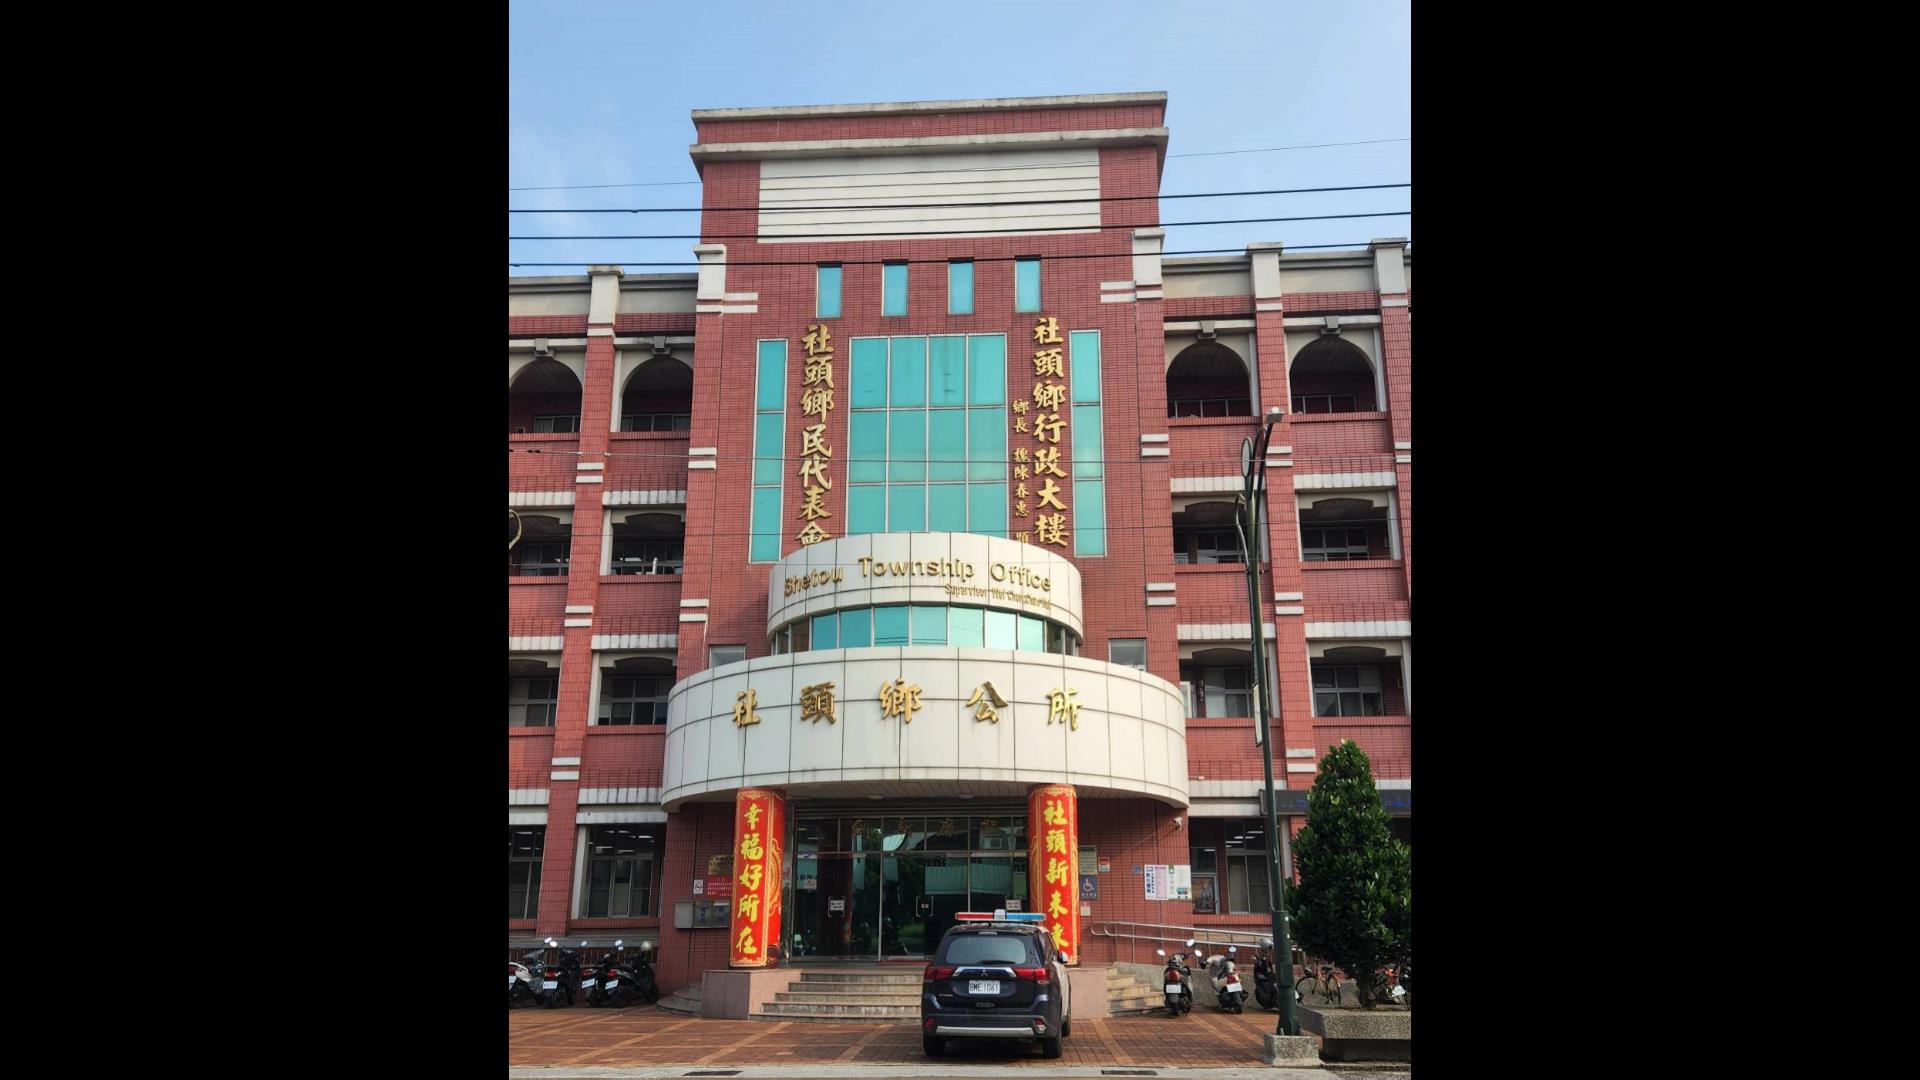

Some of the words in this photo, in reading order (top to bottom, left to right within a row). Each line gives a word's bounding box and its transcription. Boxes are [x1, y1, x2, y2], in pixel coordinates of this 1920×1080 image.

[1013, 399, 1030, 434] 鄉長
[1033, 317, 1070, 547] 社頭鄉行政大樓
[784, 567, 844, 597] Shetou
[858, 556, 976, 583] Township
[990, 561, 1052, 592] Office
[945, 583, 987, 598] Supervisor
[732, 677, 1082, 732] 社頭鄉公所
[735, 803, 764, 954] 幸福好所在
[1043, 800, 1070, 951] 社頭新未來
